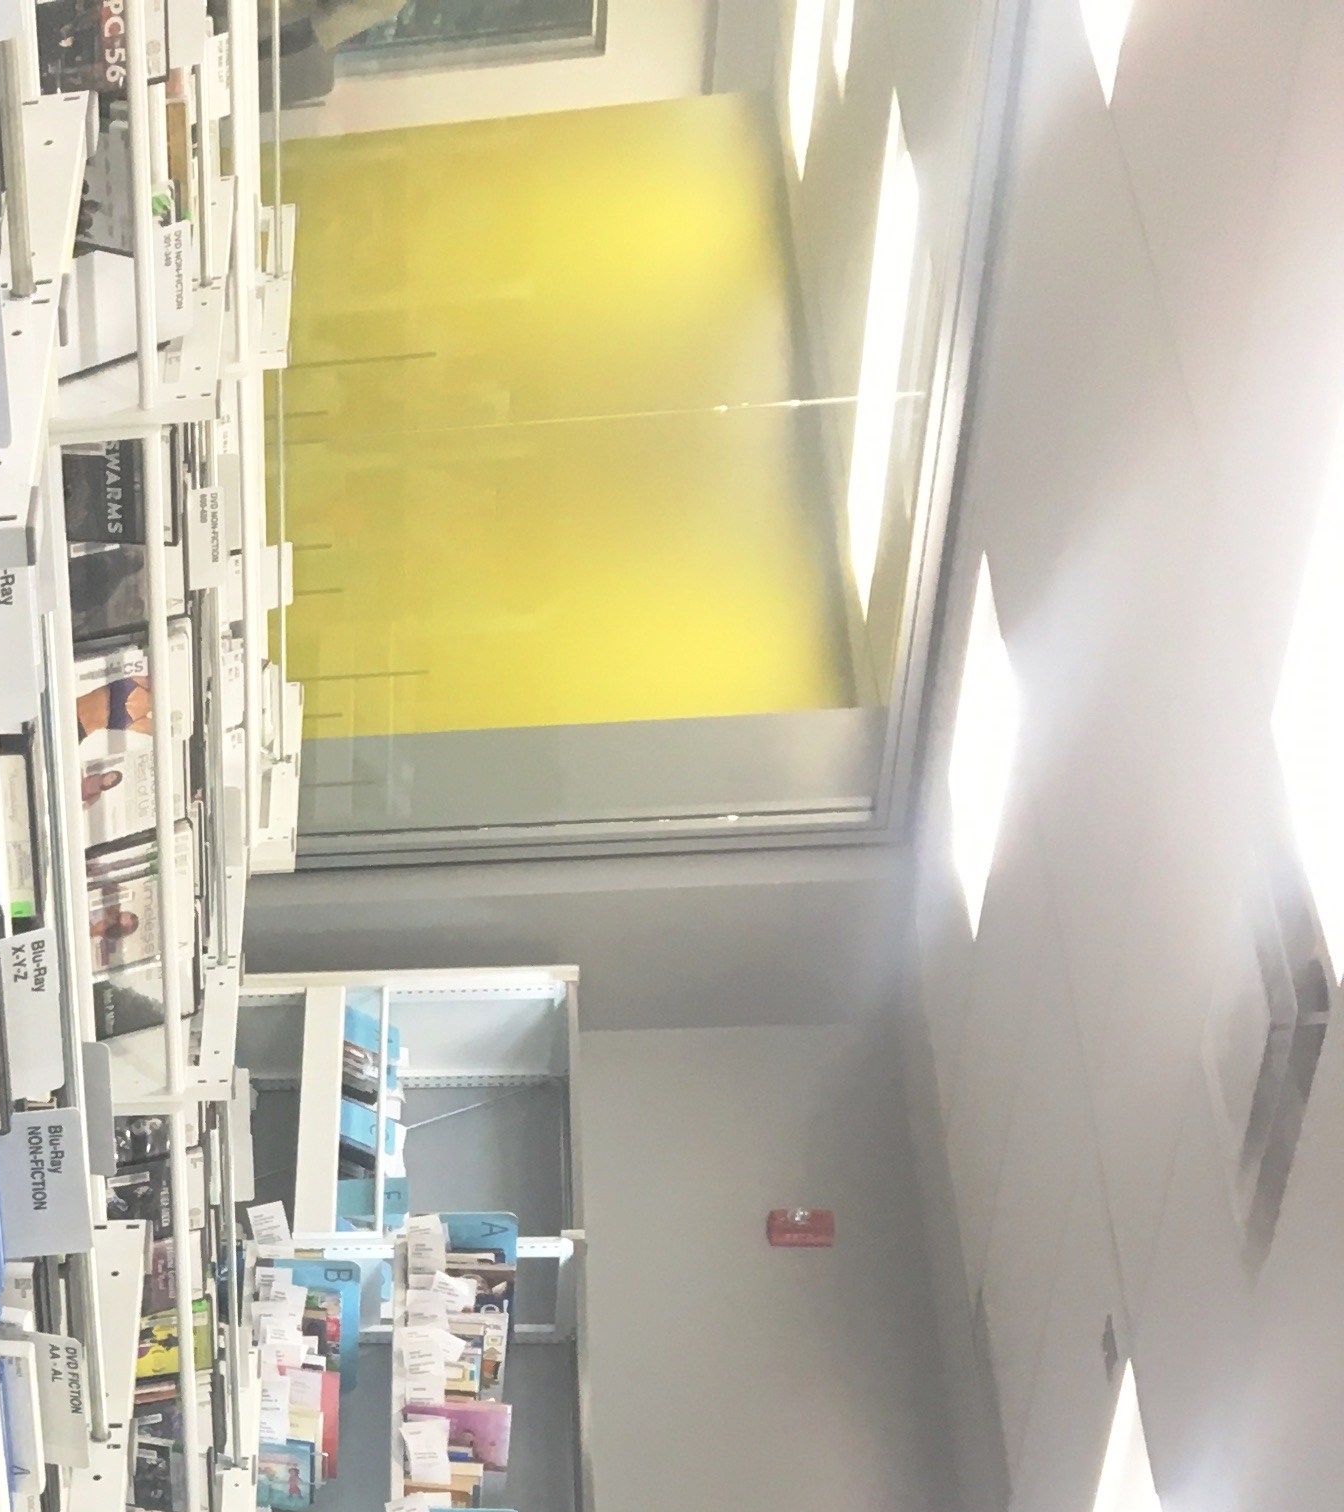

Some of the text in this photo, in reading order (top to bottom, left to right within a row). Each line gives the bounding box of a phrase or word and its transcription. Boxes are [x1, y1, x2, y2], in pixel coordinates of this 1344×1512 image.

[11, 944, 28, 983] X-Y-Z
[31, 940, 48, 993] Blu-Ray
[26, 1125, 48, 1211] NON-FICTION
[47, 1125, 65, 1174] Blu-Ray
[481, 1221, 510, 1237] A
[323, 1267, 354, 1283] B
[49, 1344, 61, 1360] AA
[51, 1368, 63, 1383] AL
[64, 1346, 83, 1415] DVD FICTION
